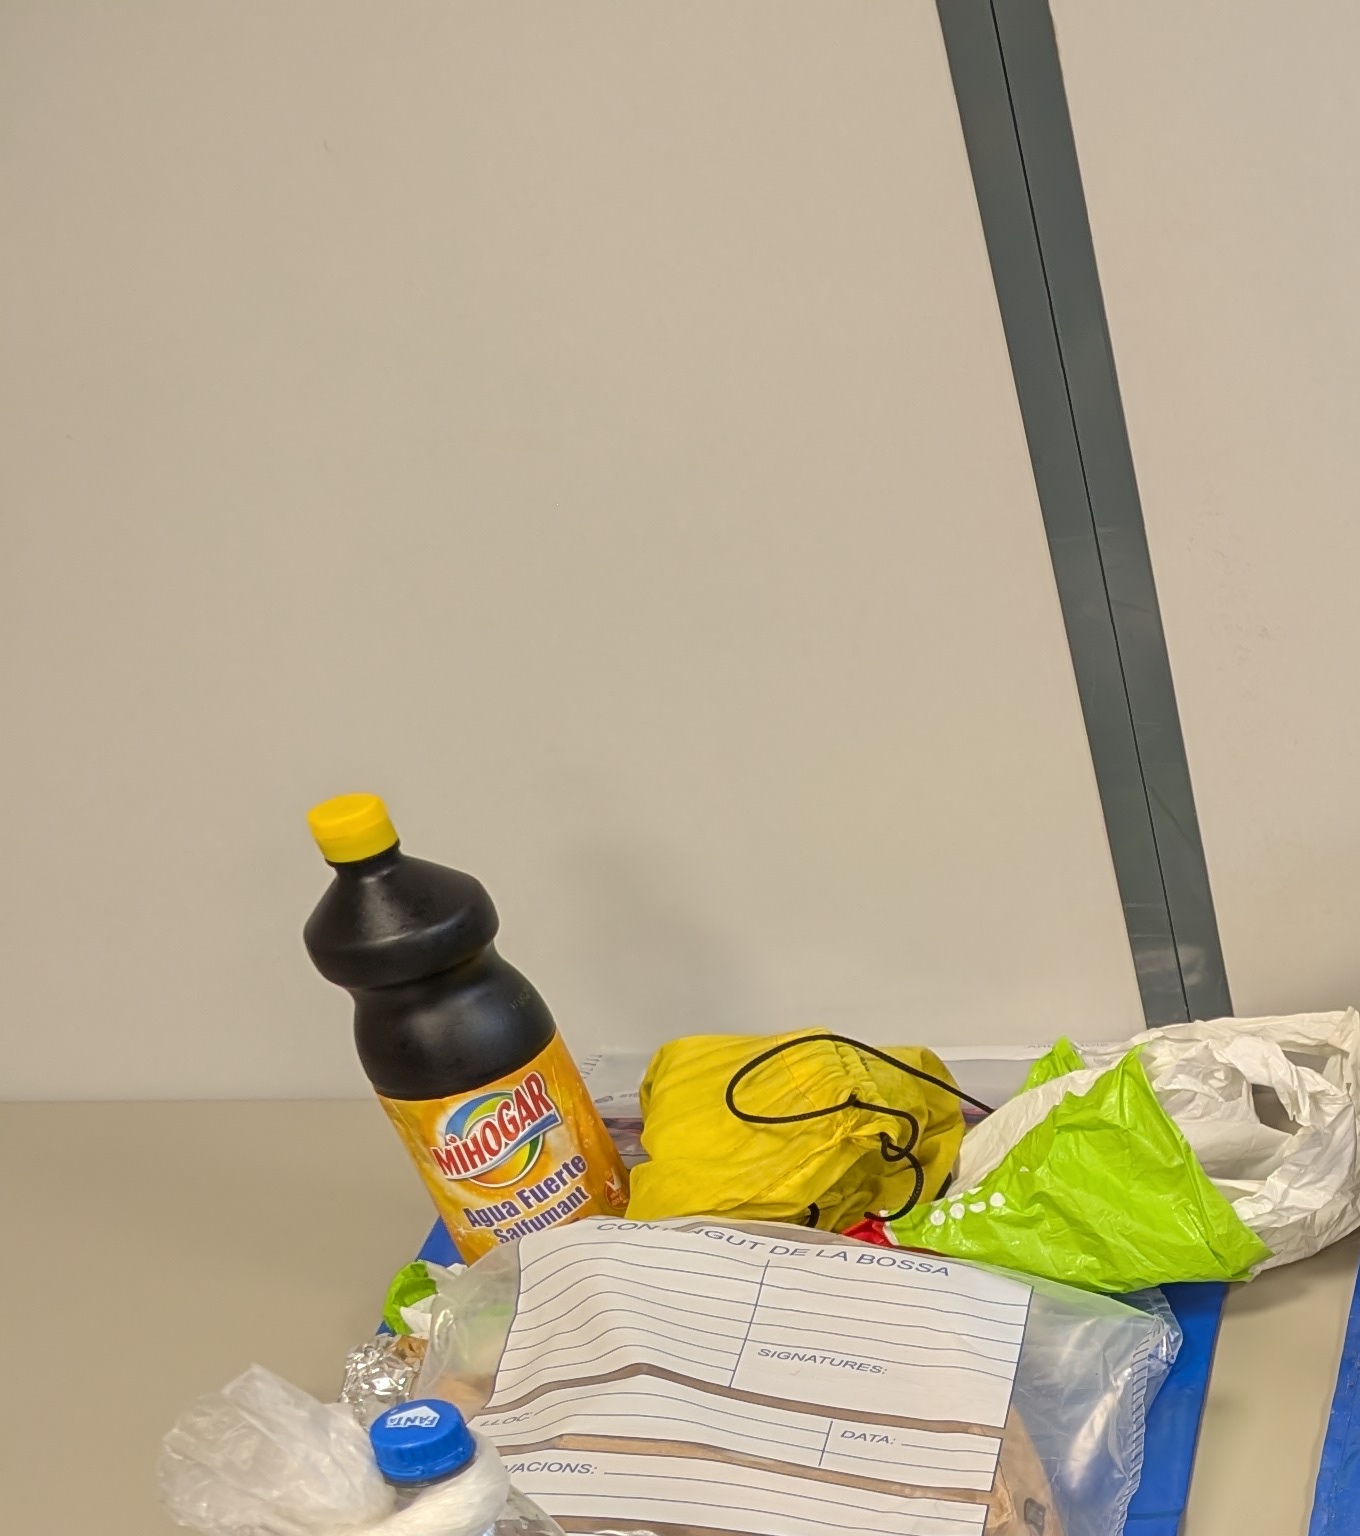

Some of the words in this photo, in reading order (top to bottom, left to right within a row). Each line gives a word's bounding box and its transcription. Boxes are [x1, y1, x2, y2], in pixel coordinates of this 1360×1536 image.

[430, 1071, 555, 1179] MIHOGAR
[462, 1197, 520, 1229] Agua
[516, 1153, 588, 1213] Fuerte
[493, 1184, 592, 1245] Salfumant
[769, 1242, 810, 1259] DE
[816, 1247, 850, 1262] LA
[857, 1252, 950, 1278] BOSSA
[756, 1346, 888, 1376] SIGNATURES:
[389, 1415, 439, 1426] FANTA
[840, 1429, 898, 1446] DATA:
